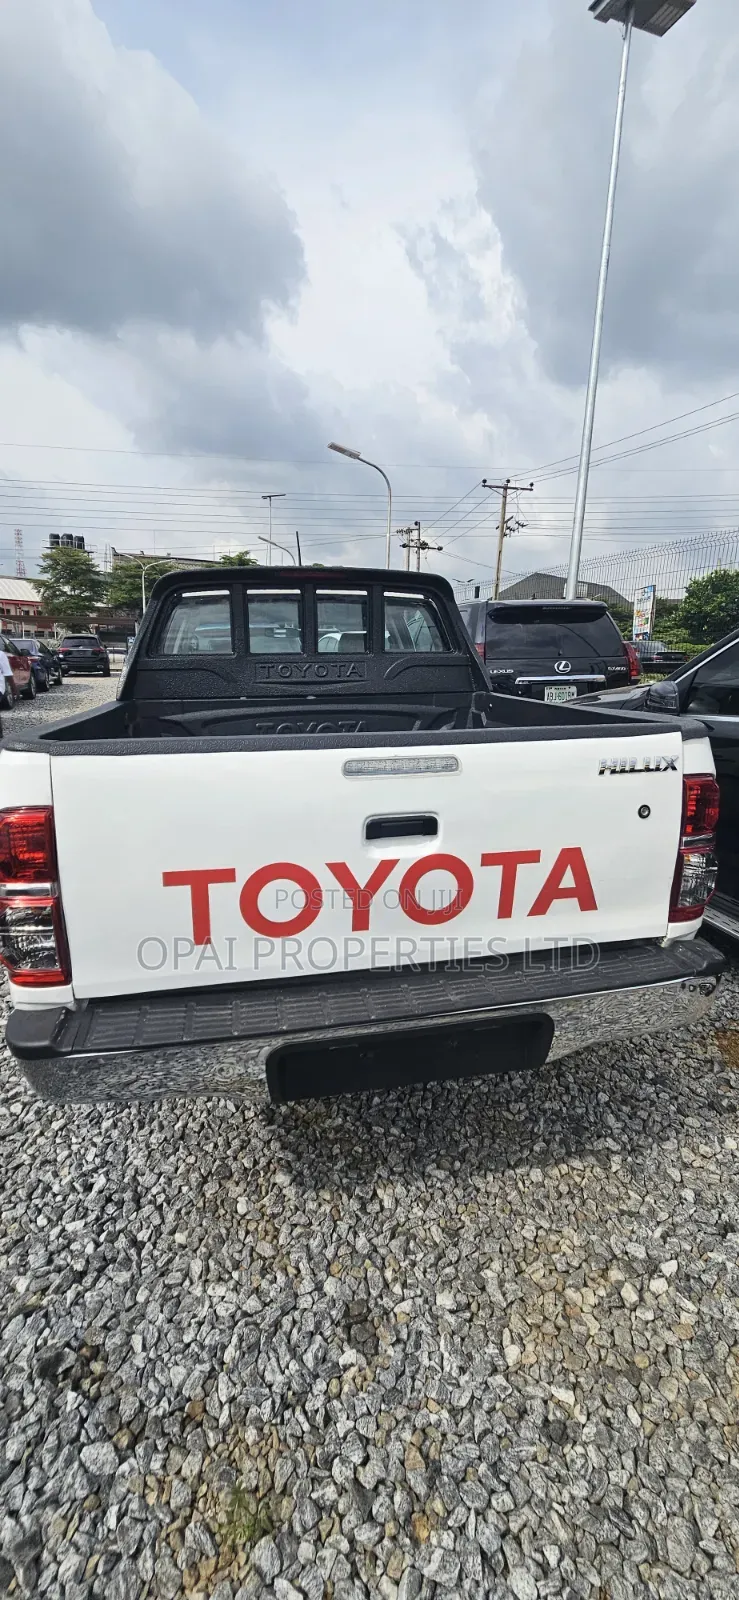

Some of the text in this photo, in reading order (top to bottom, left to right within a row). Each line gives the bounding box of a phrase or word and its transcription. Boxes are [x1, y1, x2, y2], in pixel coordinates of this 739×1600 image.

[259, 662, 363, 679] TOYOTA
[598, 755, 679, 775] HILUX
[162, 846, 599, 946] TOYOTA
